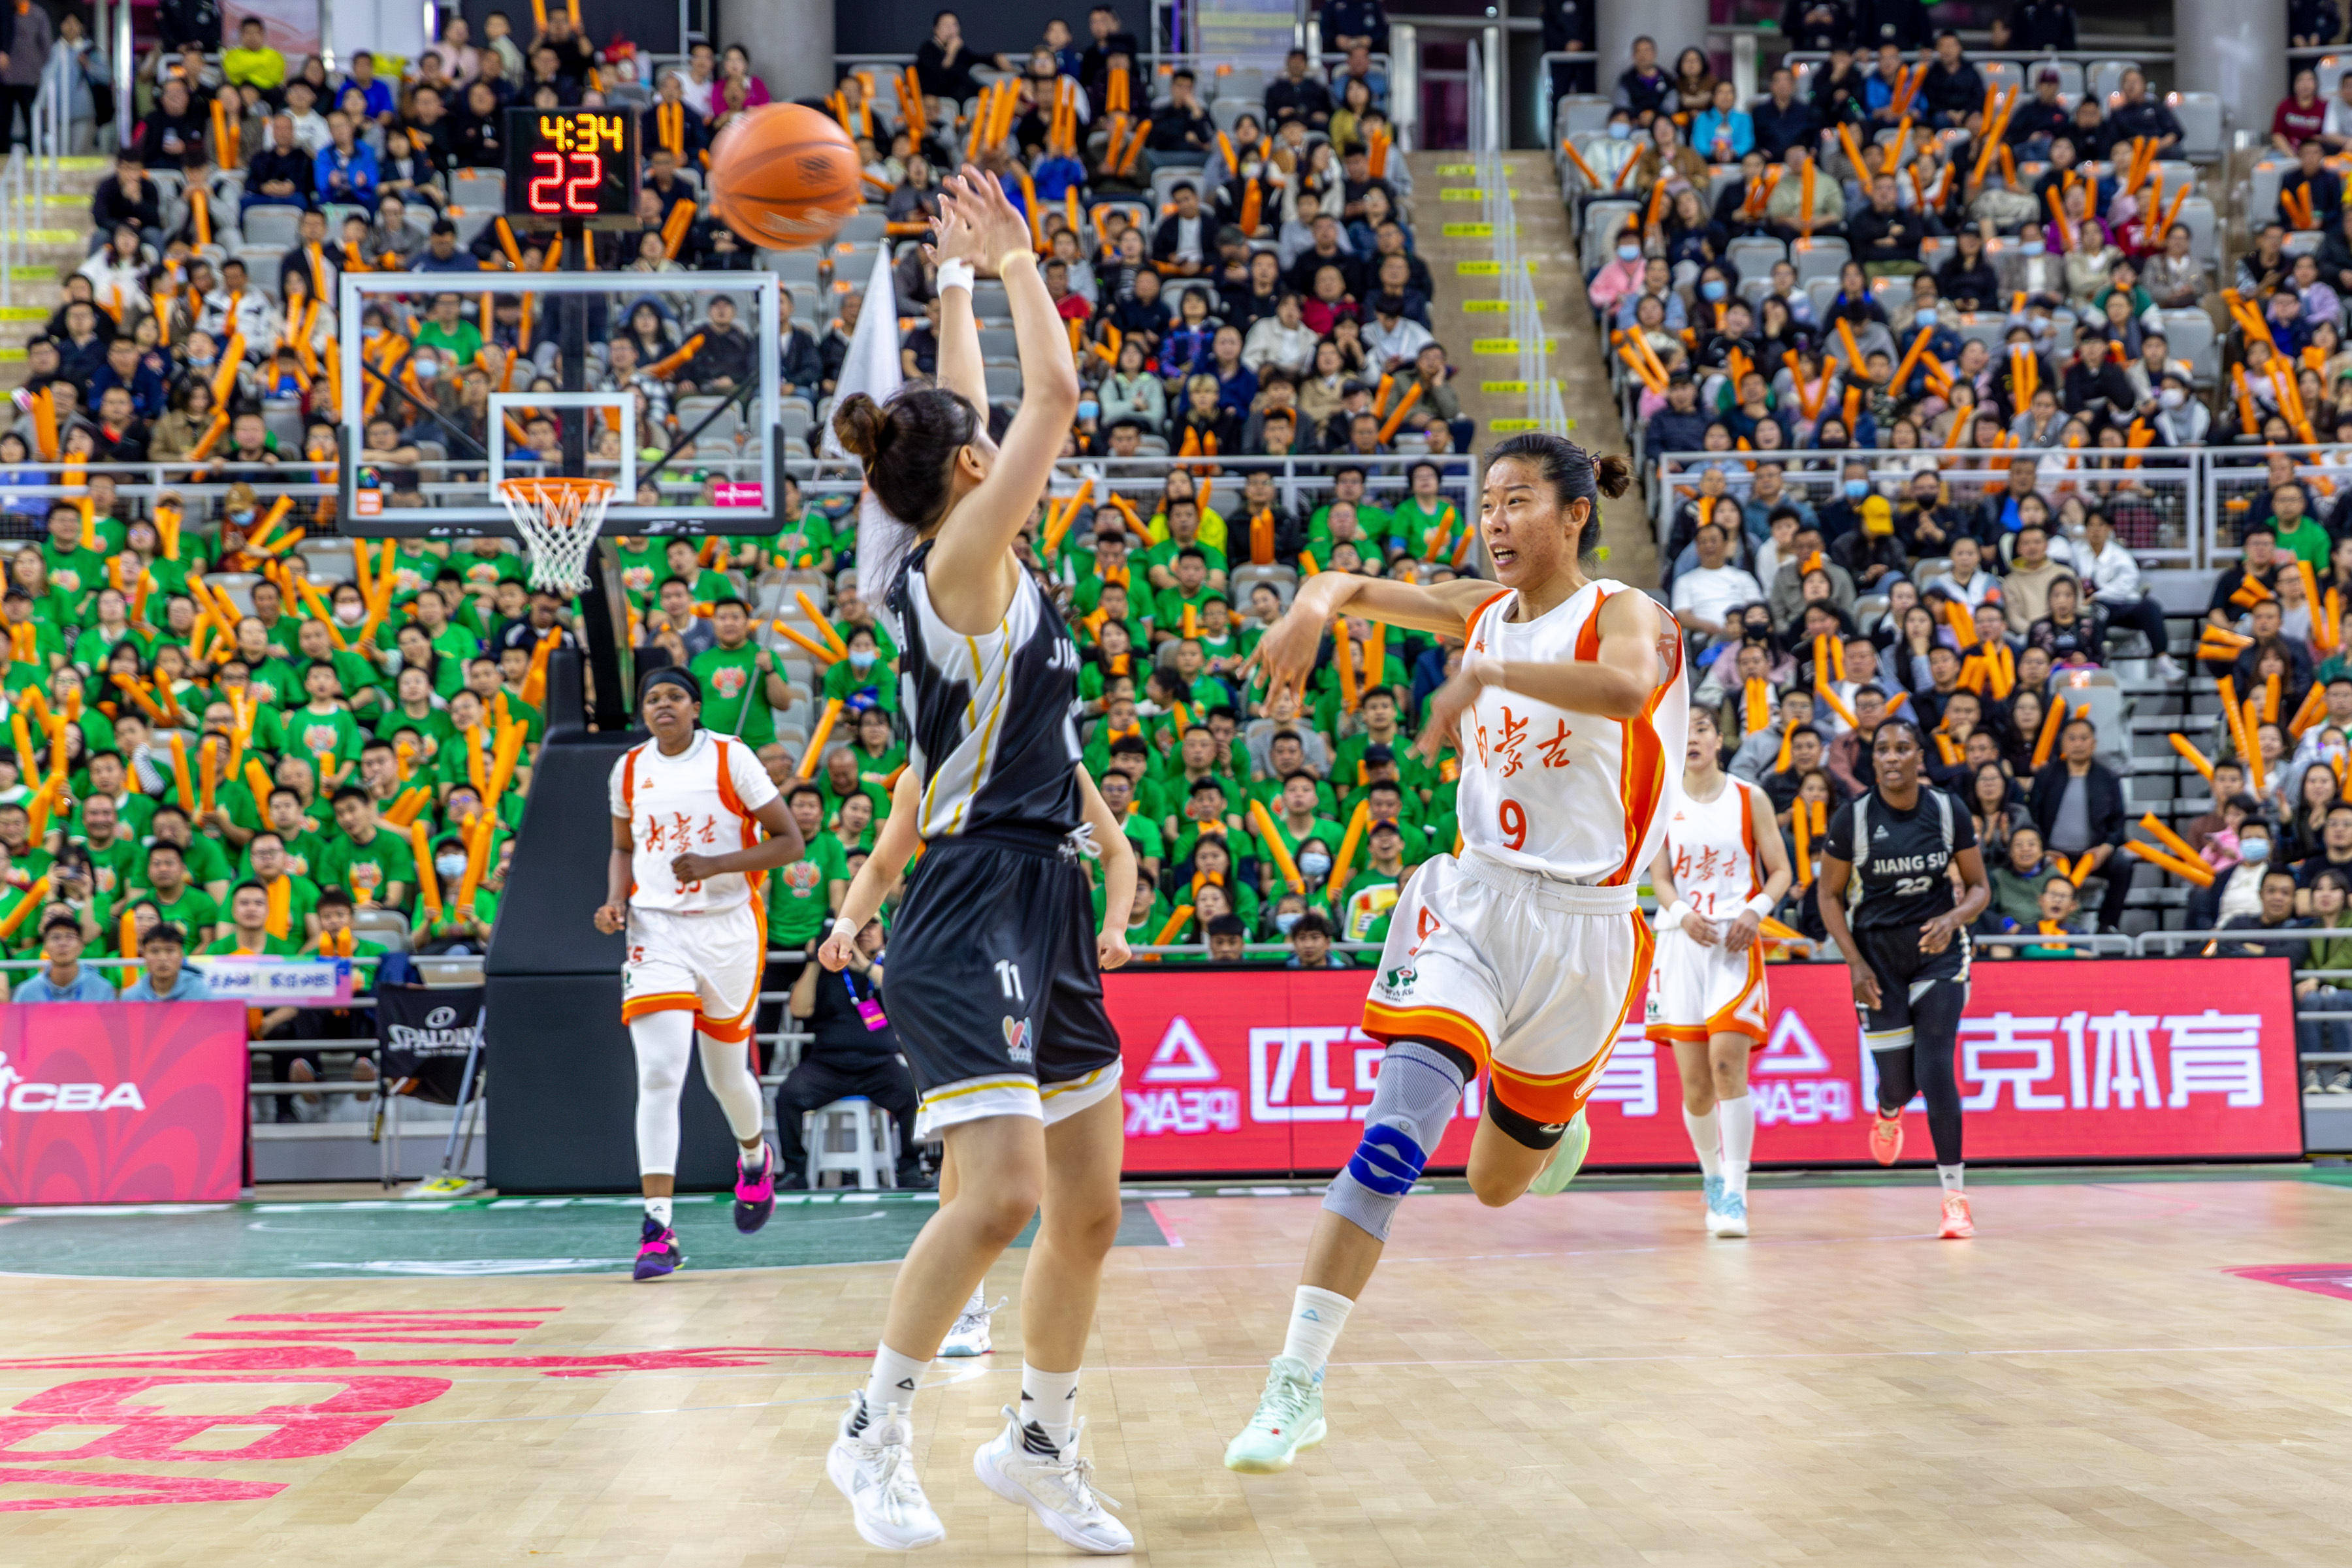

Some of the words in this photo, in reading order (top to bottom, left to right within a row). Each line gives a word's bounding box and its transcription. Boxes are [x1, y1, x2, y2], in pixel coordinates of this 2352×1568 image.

[540, 112, 623, 153] 4:34
[528, 151, 602, 214] 22
[645, 811, 717, 854] 内蒙古
[1499, 799, 1527, 851] 9
[1673, 844, 1737, 881] 内蒙古
[1872, 854, 1925, 875] JIANG
[1925, 851, 1947, 871] SU
[1689, 890, 1716, 916] 21
[994, 959, 1024, 1001] 11
